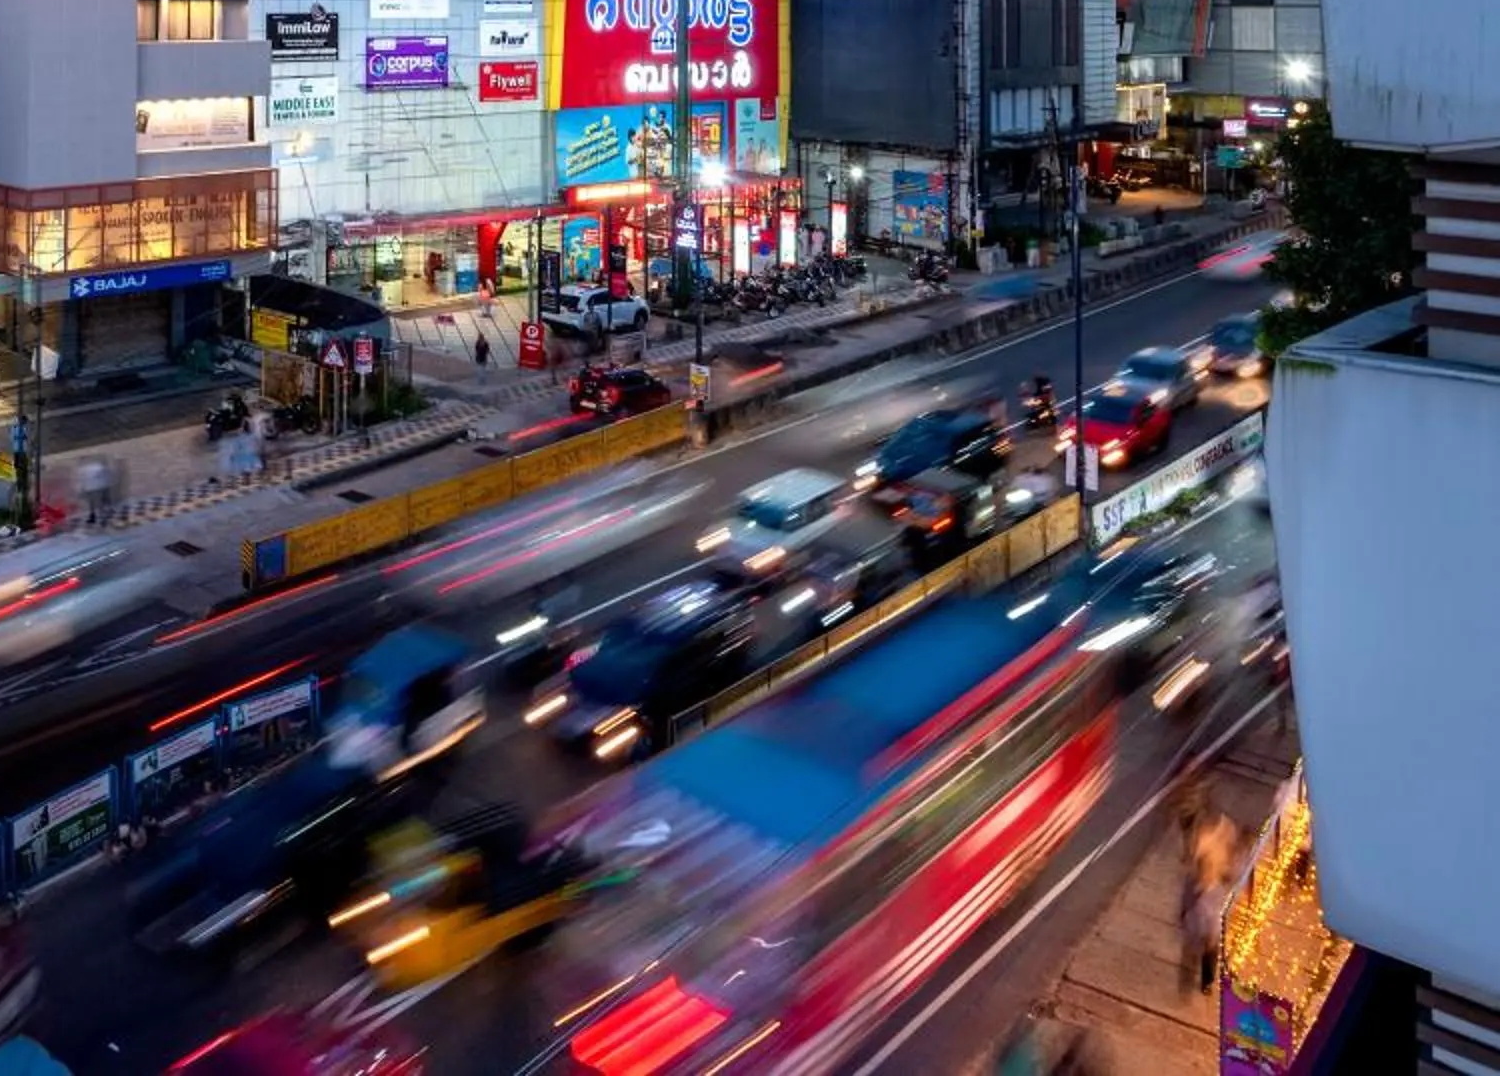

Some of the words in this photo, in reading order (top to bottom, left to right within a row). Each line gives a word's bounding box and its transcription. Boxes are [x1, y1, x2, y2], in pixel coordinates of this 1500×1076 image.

[387, 56, 433, 72] corpus
[273, 97, 311, 111] MIDDLE
[313, 95, 335, 109] EAST
[93, 274, 147, 292] BAJAJ
[1103, 497, 1125, 531] SSF
